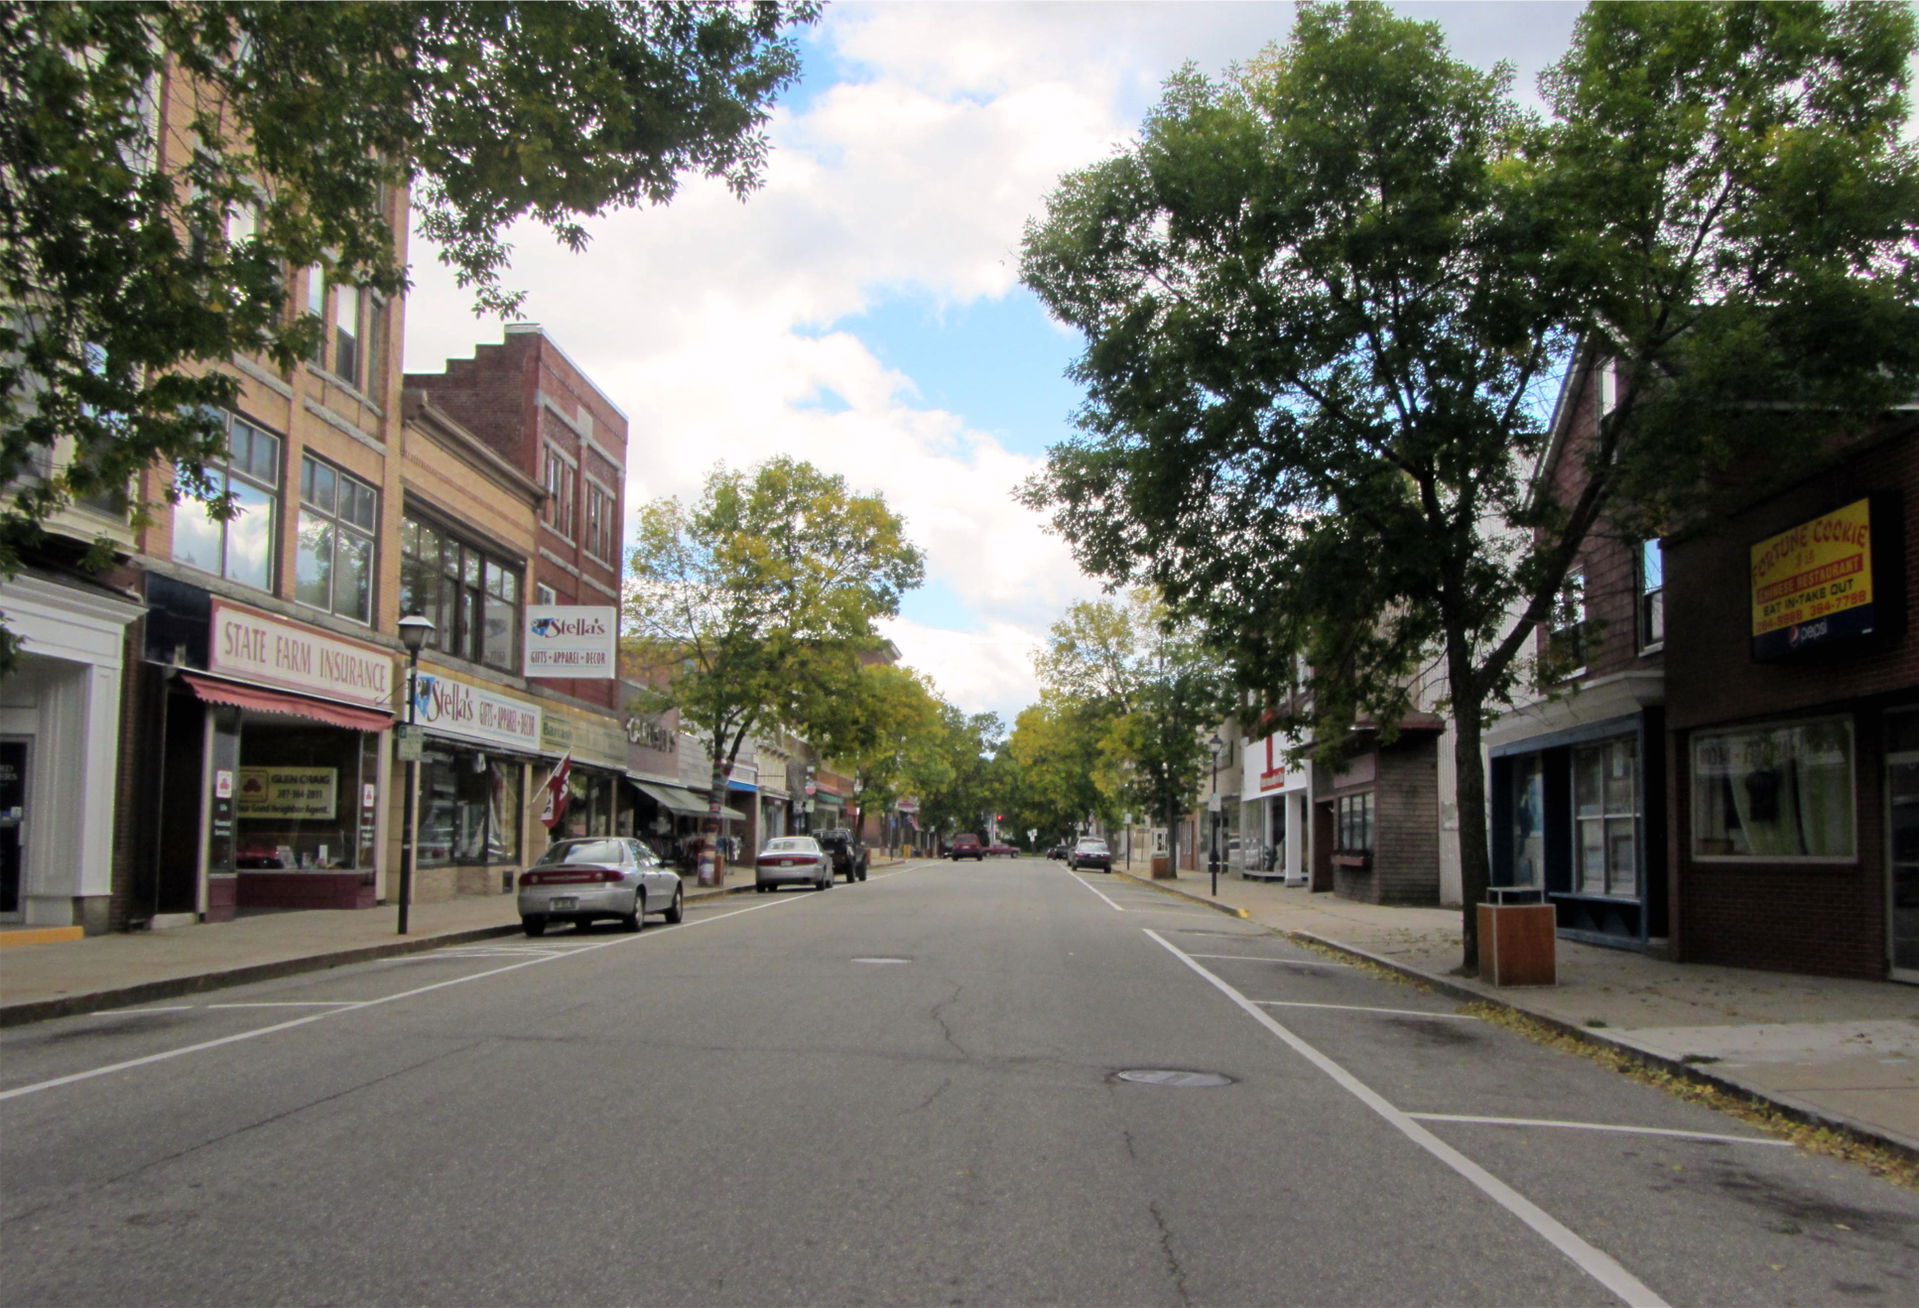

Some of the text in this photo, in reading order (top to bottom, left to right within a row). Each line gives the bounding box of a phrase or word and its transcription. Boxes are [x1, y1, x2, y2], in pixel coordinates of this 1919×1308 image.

[1752, 526, 1808, 584] FORTUNE
[1813, 519, 1868, 548] COOKIE
[1758, 578, 1794, 603] CHINESE
[1796, 556, 1859, 589] RESTAURANT
[1763, 602, 1781, 616] EAT
[1830, 578, 1854, 595] OUT
[545, 617, 606, 639] Stella's
[225, 621, 385, 693] STATE FARM INSURANCE
[530, 651, 606, 665] GIFTS APPAREL DECOR
[427, 680, 474, 723] Stella's
[480, 701, 535, 737] GIFTS APPAREL DECOR
